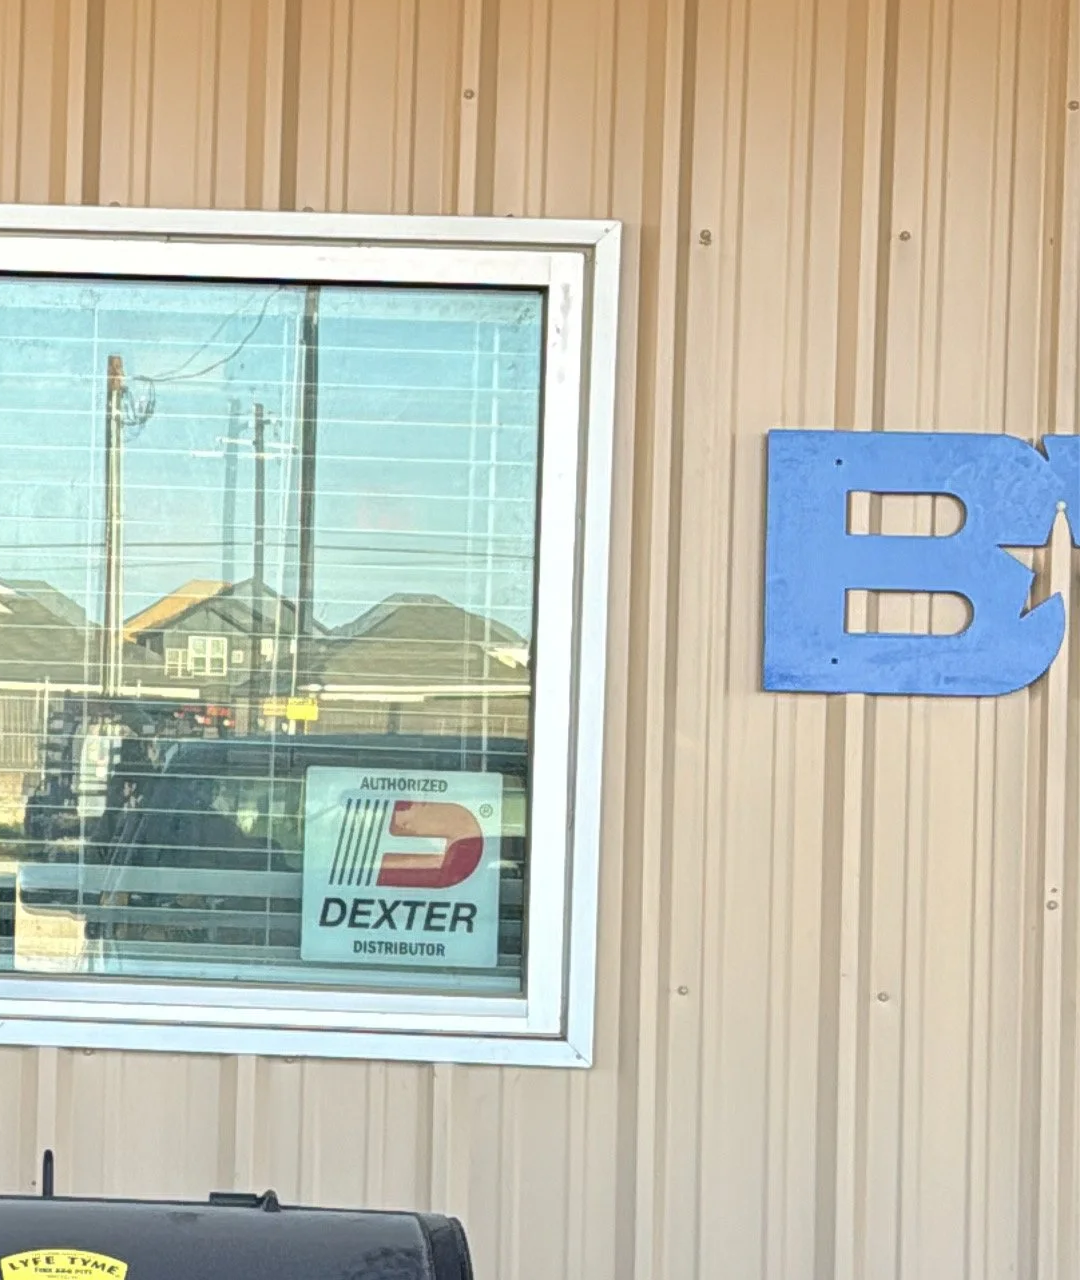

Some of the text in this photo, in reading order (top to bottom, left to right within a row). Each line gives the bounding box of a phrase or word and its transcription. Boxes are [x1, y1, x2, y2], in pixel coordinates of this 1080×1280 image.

[360, 777, 448, 792] AUTHORIZED
[318, 897, 478, 933] DEXTER
[353, 940, 446, 957] DISTRIBUTOR
[8, 1256, 120, 1275] LYFE TYME
